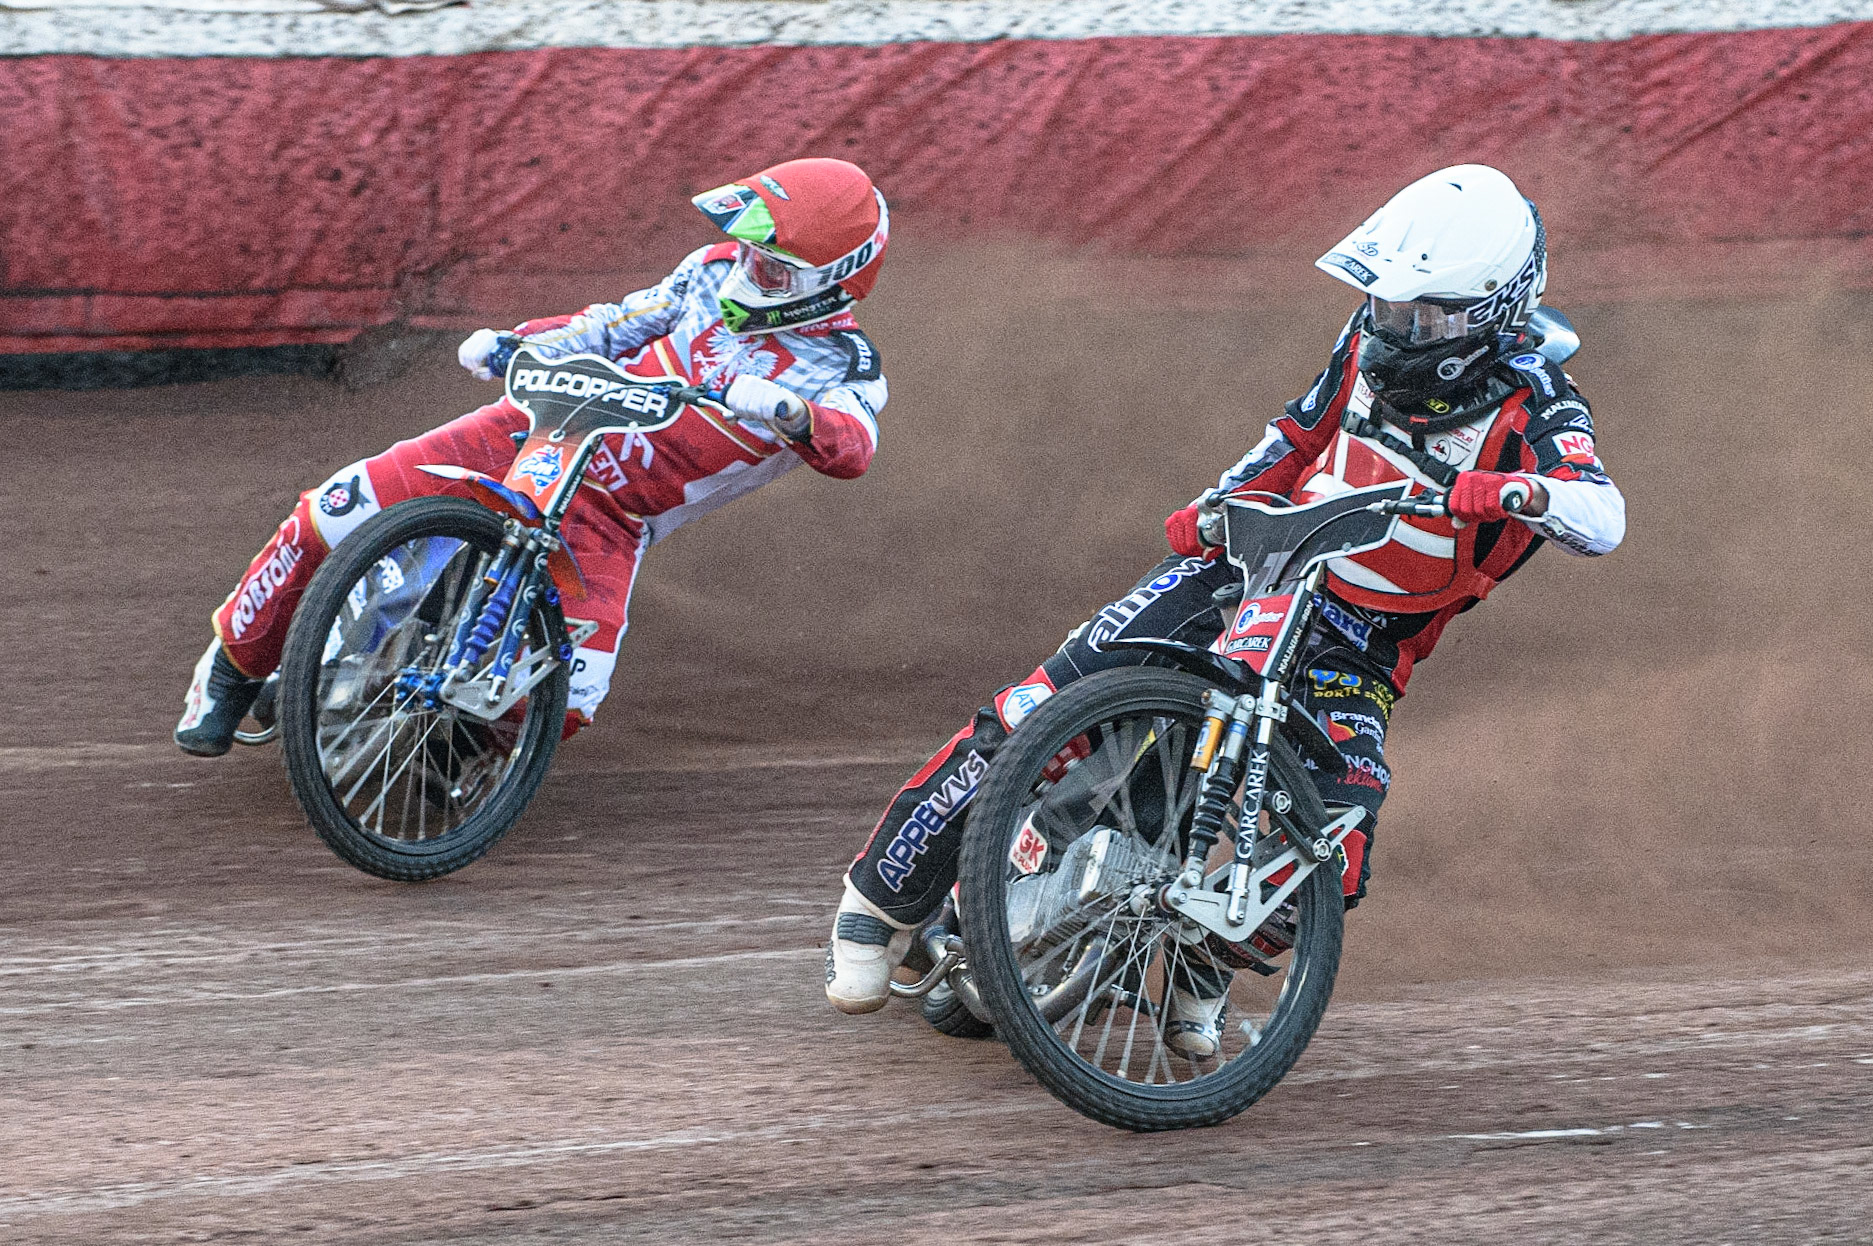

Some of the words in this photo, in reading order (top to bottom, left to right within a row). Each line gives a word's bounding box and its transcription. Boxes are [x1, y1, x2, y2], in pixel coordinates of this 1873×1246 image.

[783, 296, 838, 318] MONSTER
[512, 369, 669, 419] POLCOPPER
[1236, 750, 1270, 859] GARCAREK
